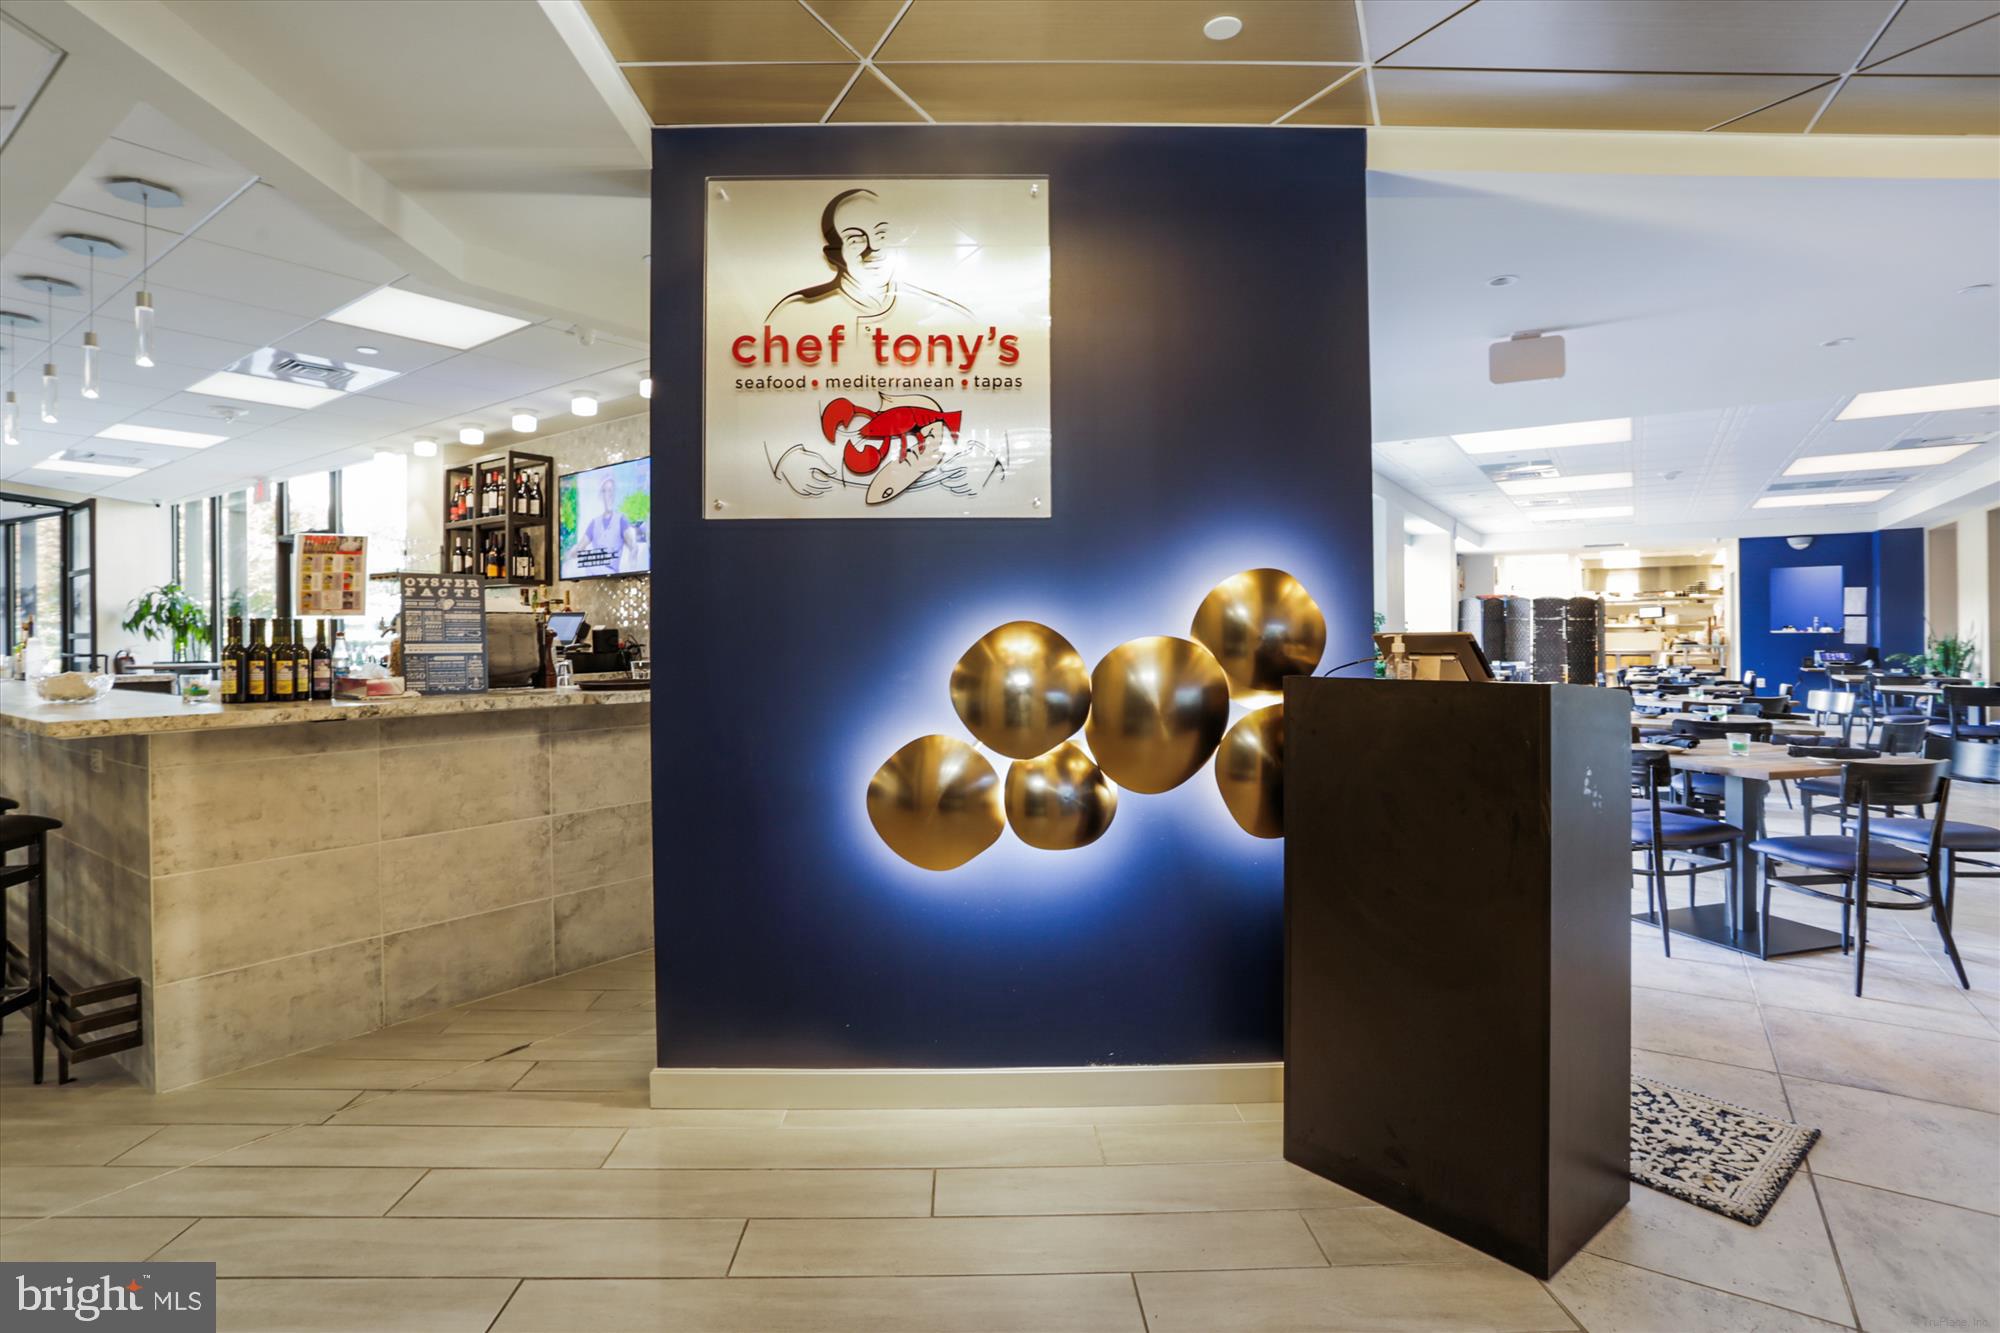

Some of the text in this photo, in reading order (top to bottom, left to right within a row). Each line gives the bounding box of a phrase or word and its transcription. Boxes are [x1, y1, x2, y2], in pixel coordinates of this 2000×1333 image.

[732, 325, 1020, 370] chef tony's
[735, 375, 1022, 391] seafood mediterranean tapas
[404, 577, 479, 588] OYSTER
[404, 587, 480, 598] FACTS
